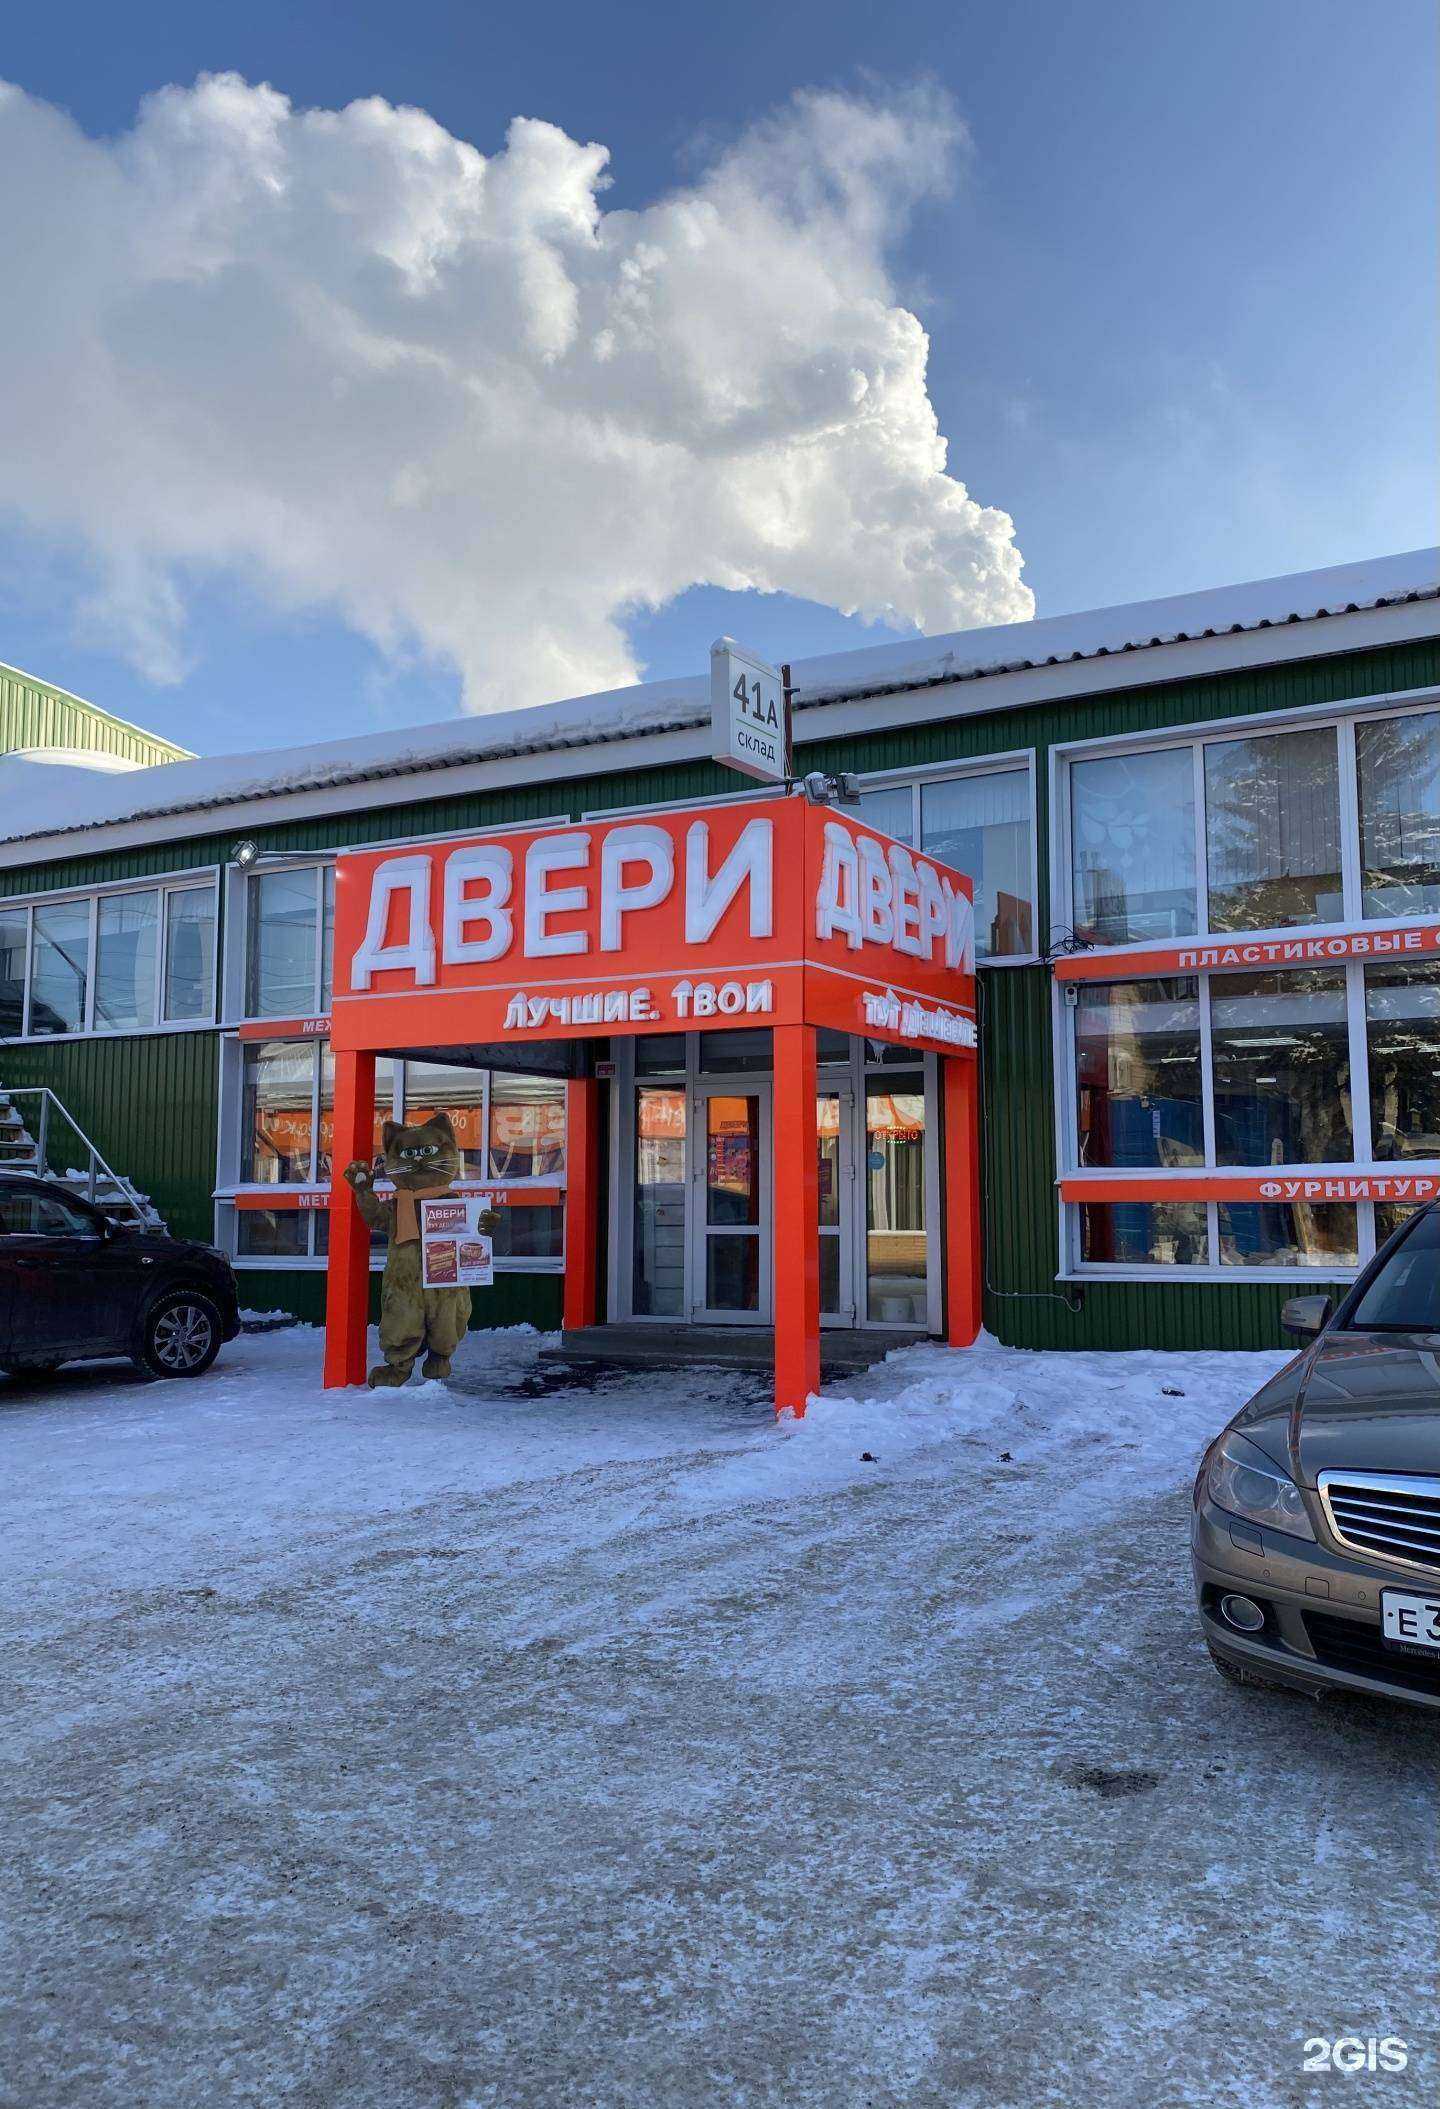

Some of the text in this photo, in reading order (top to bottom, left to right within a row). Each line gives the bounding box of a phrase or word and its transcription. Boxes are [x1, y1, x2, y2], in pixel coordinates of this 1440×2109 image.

[737, 731, 776, 764] склад
[350, 818, 774, 991] ДВЕРИ
[816, 822, 976, 976] ДВЕРИ
[1178, 932, 1423, 968] ПЛАСТИКОВЫЕ
[671, 979, 774, 1018] ТВОИ
[862, 988, 902, 1030] ТУТ
[427, 1208, 466, 1221] ДВЕРИ
[1400, 1645, 1440, 1660] Mercedes-
